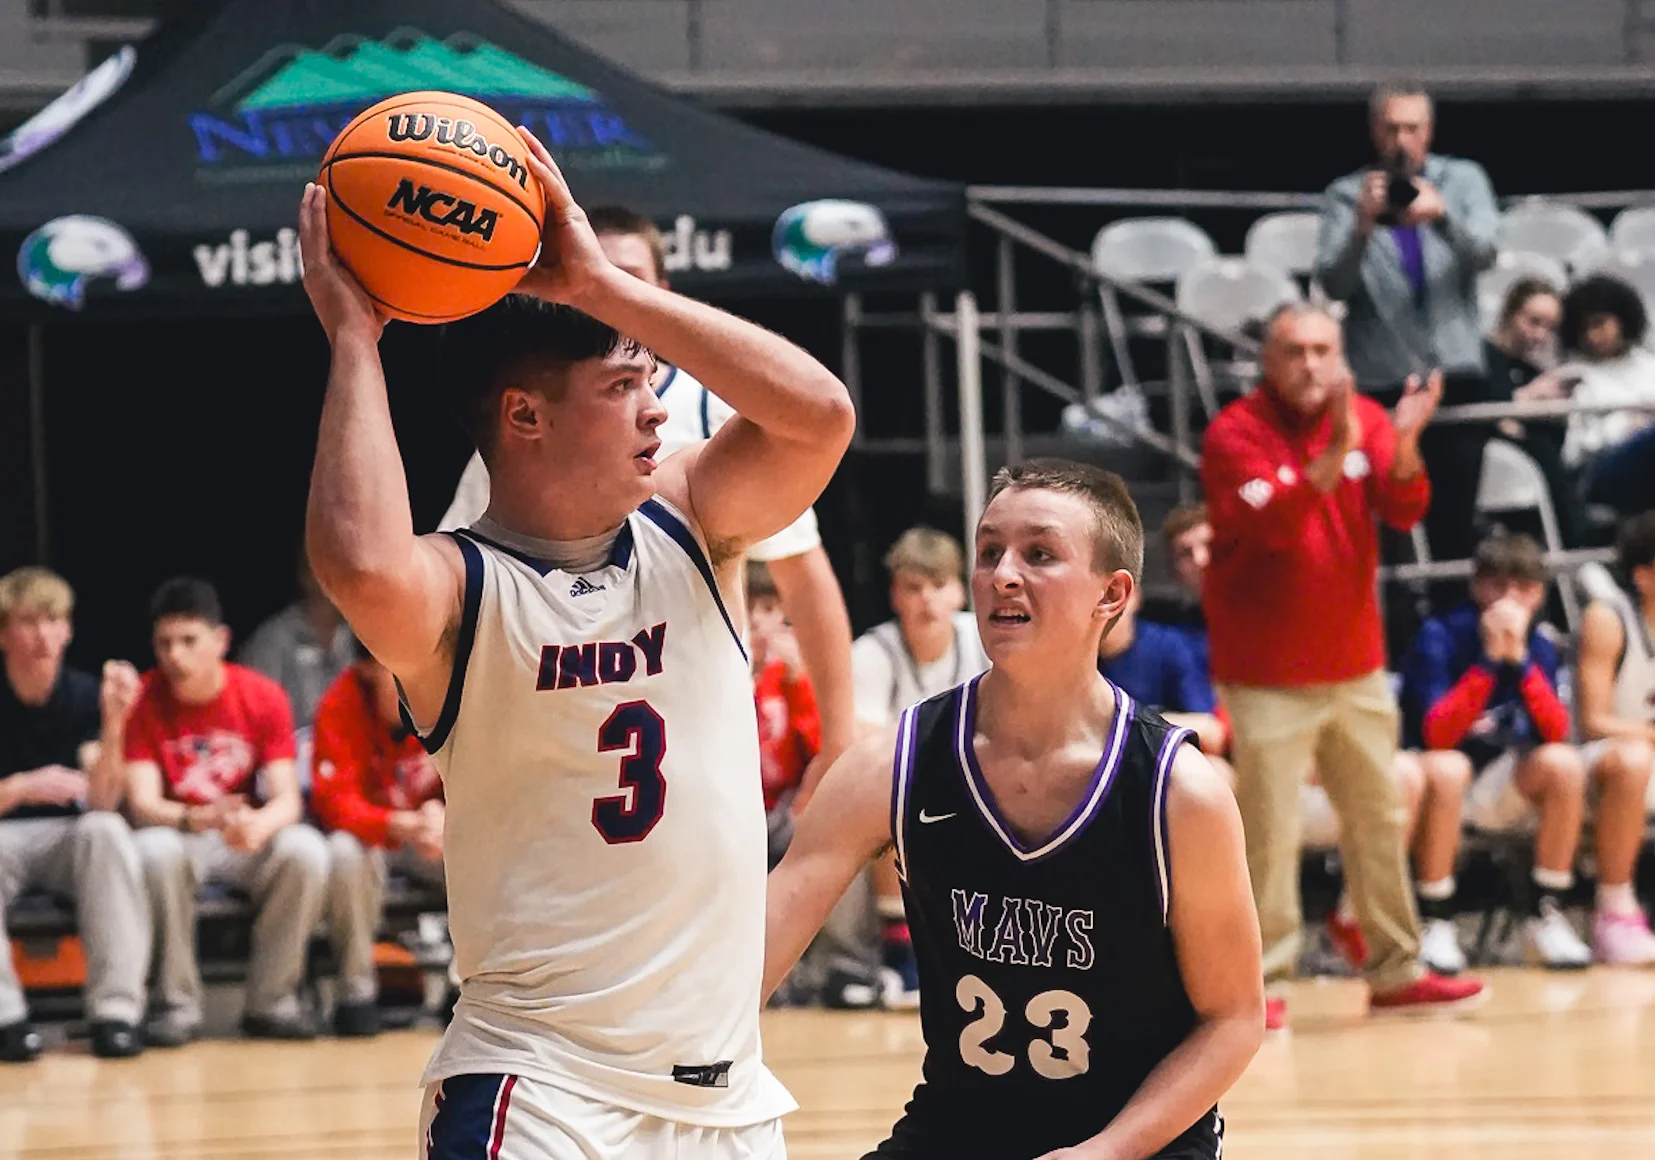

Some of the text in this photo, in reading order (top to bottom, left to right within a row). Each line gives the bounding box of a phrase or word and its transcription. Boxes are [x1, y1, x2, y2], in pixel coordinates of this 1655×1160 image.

[387, 112, 528, 191] Wilson
[386, 177, 498, 242] NCAA
[193, 214, 732, 287] visi du
[536, 621, 667, 691] INDY
[591, 700, 667, 845] 3
[951, 889, 1095, 970] MAVS
[955, 974, 1094, 1080] 23
